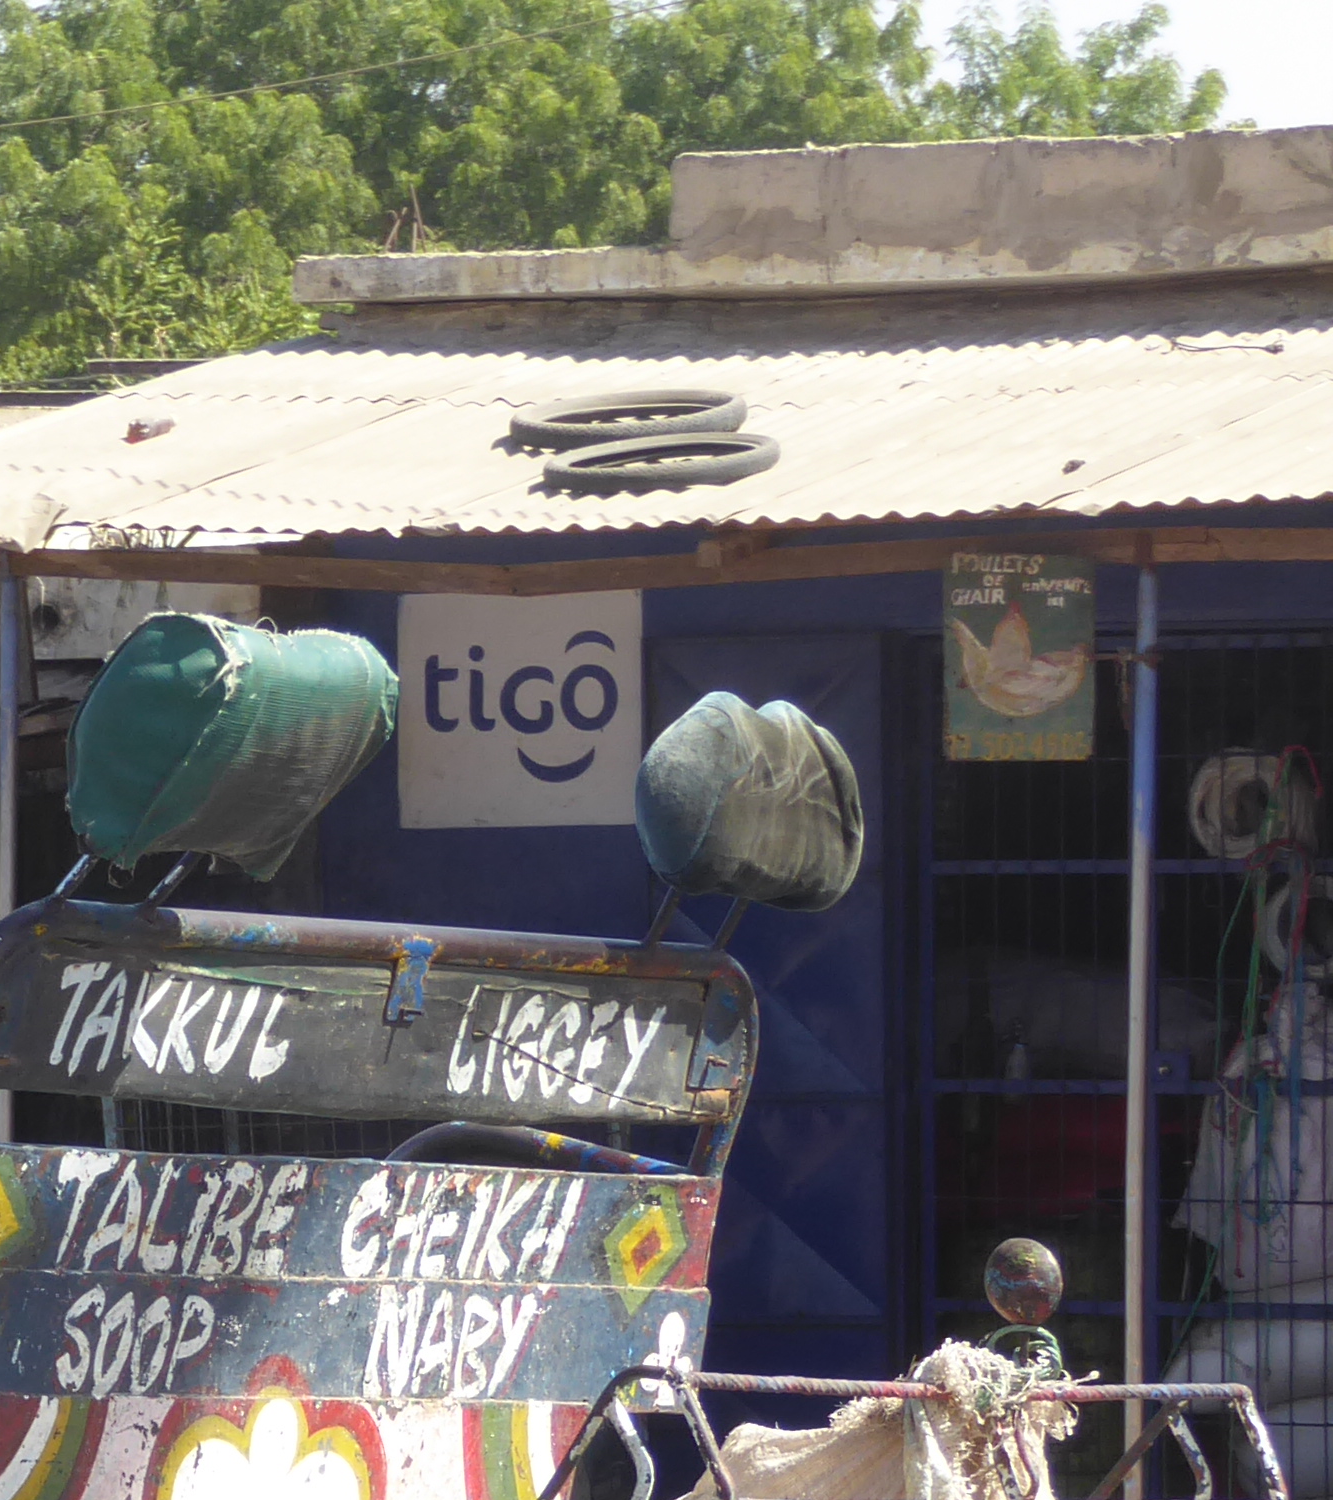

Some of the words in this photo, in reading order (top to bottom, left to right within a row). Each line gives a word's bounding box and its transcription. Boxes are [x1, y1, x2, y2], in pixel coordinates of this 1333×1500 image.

[951, 588, 1006, 606] CHAIR
[49, 962, 291, 1084] TAKKUL
[447, 984, 668, 1109] LIGGEY
[55, 1148, 308, 1278] TALIBE
[340, 1168, 585, 1281] CHEIKH
[55, 1285, 215, 1400] SOOP
[362, 1284, 537, 1400] NABY
